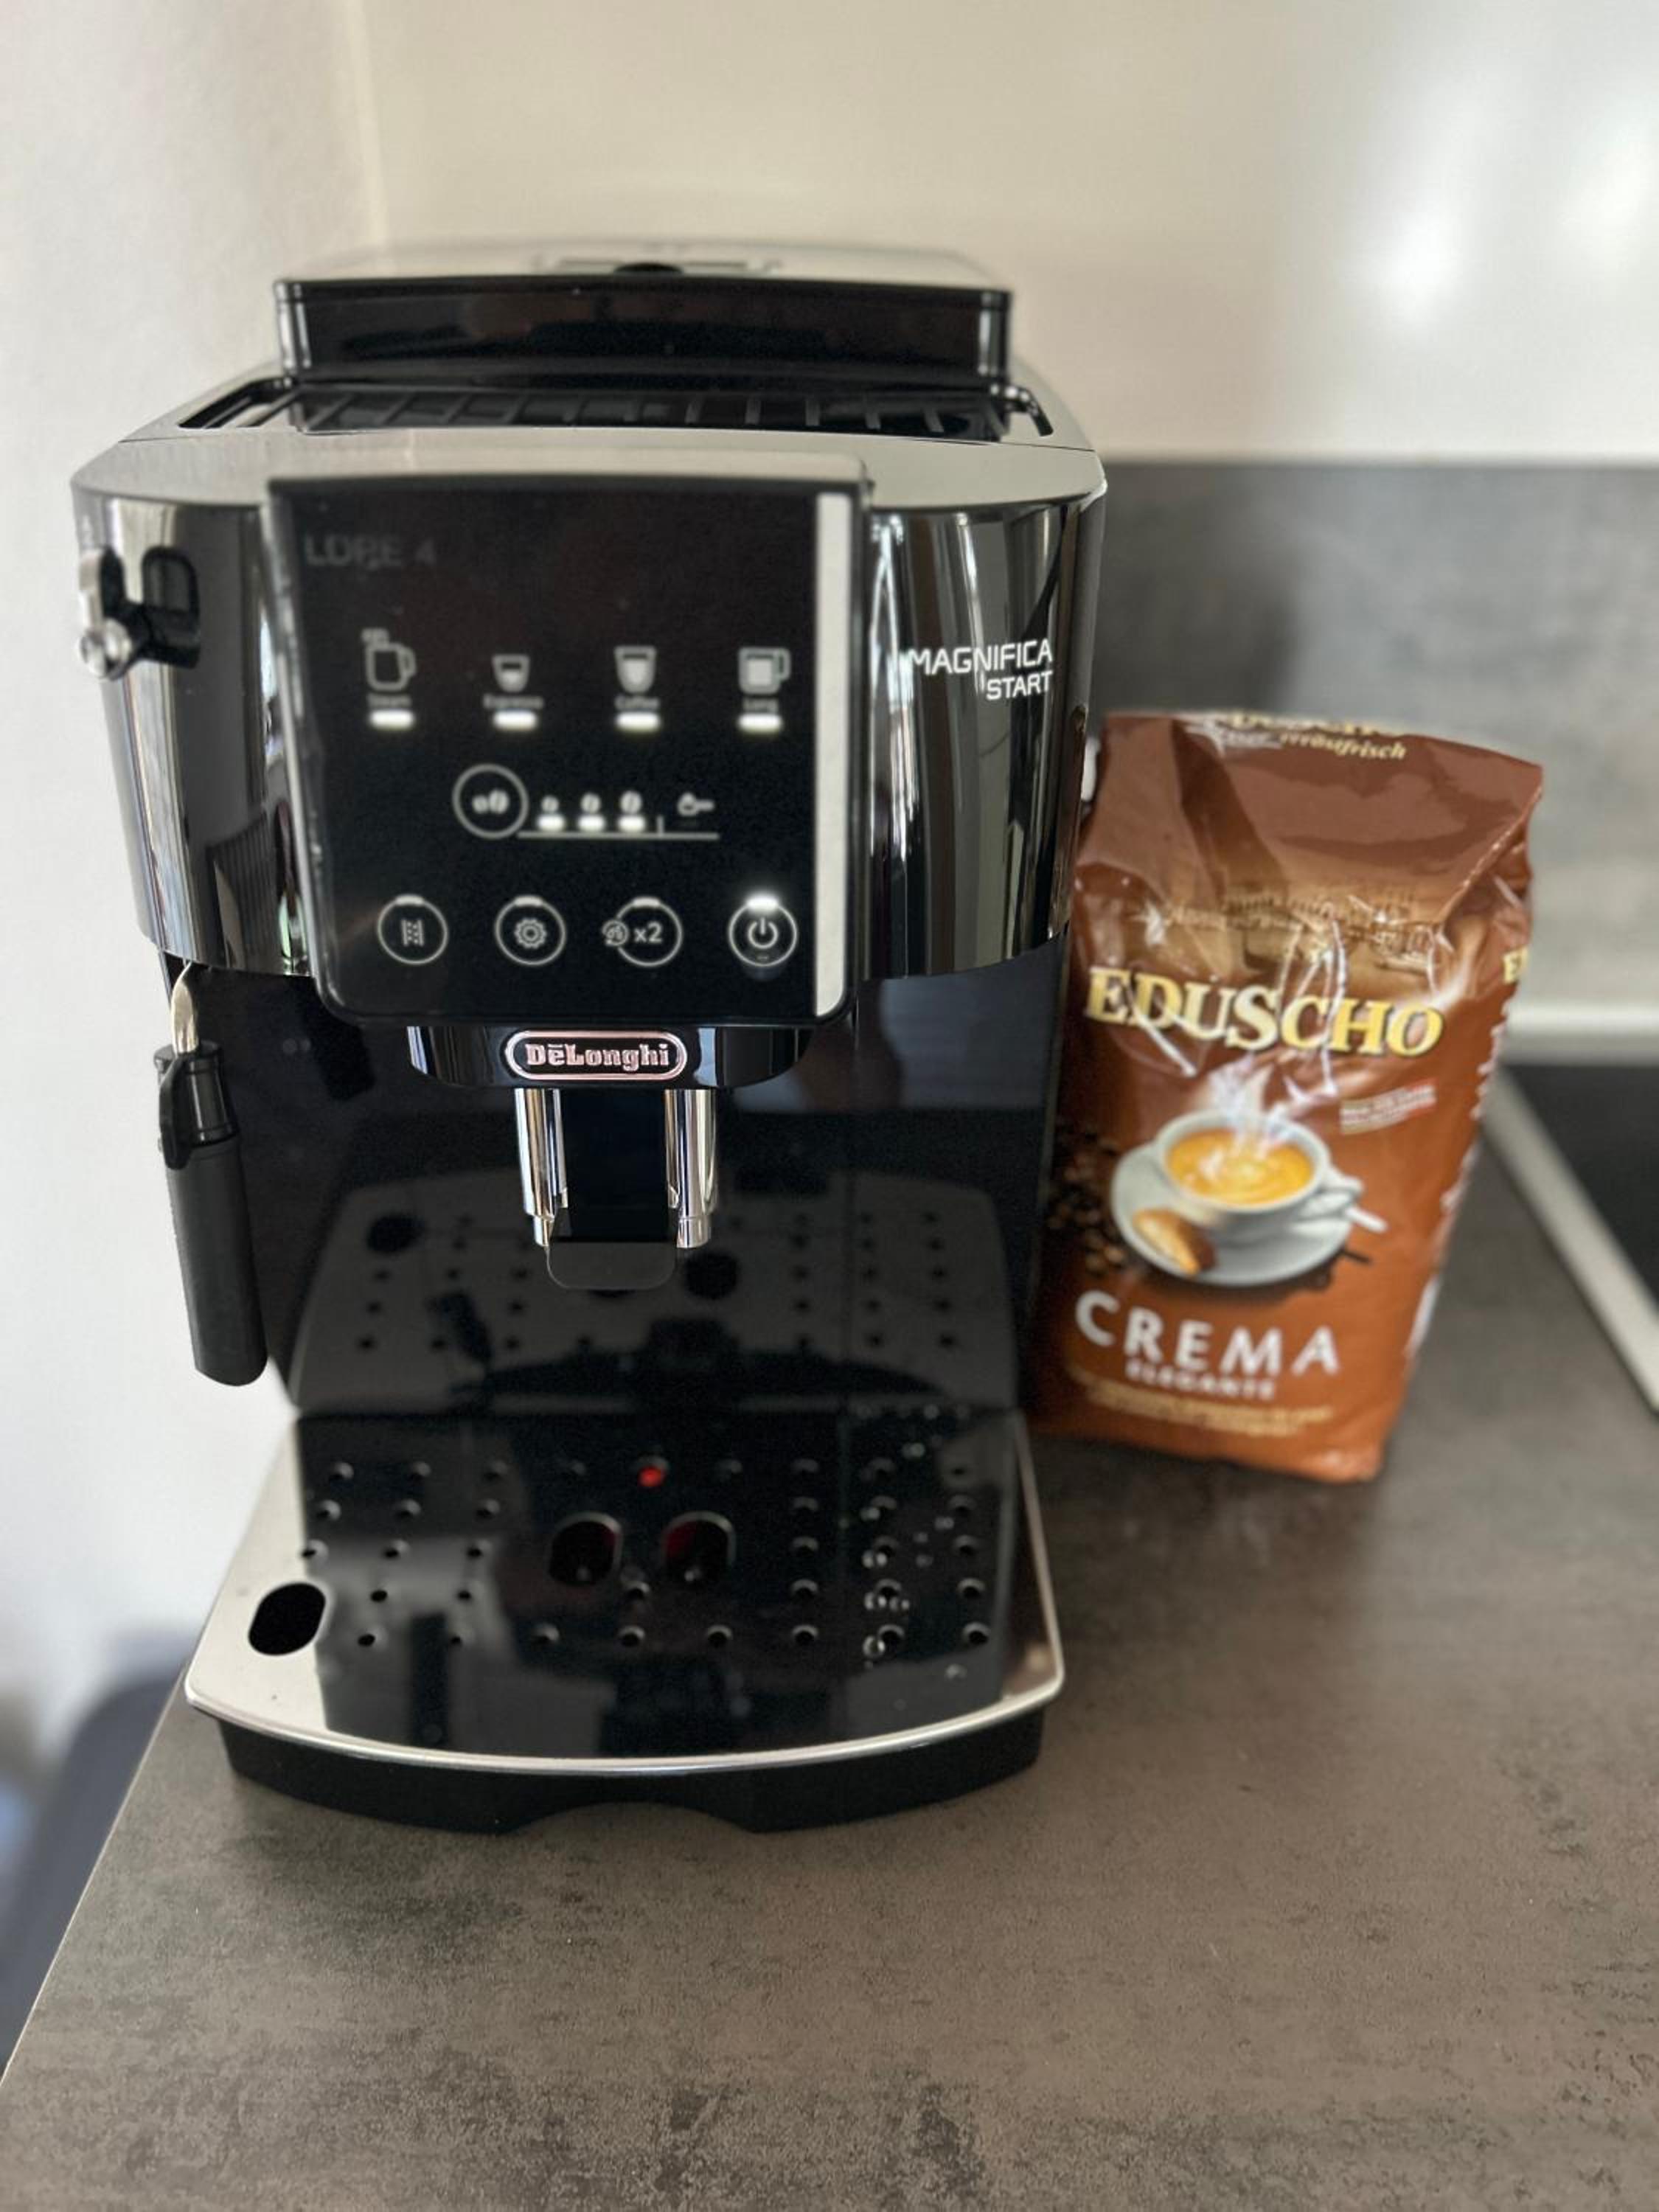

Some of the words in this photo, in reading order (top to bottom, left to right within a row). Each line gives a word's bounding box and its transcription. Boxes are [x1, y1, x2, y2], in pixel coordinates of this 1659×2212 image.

[908, 638, 1053, 675] MAGNIFICA
[987, 669, 1053, 700] START
[634, 922, 662, 943] x2
[1086, 965, 1443, 1058] EDUSCHO
[1075, 1290, 1339, 1376] CREMA
